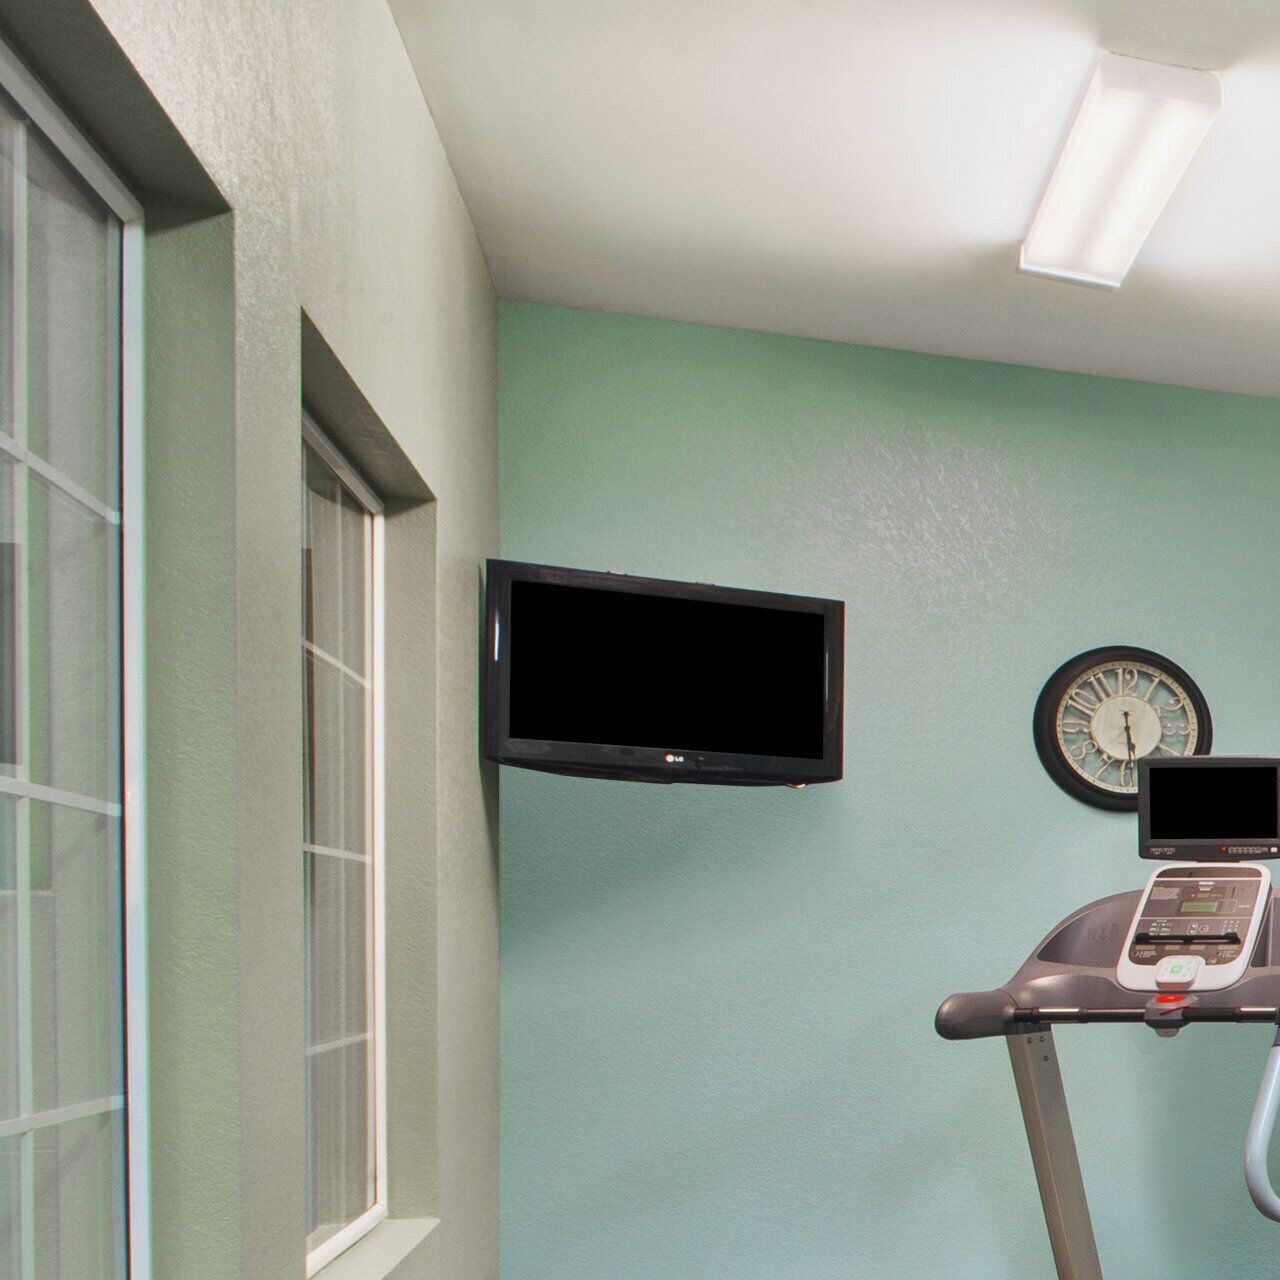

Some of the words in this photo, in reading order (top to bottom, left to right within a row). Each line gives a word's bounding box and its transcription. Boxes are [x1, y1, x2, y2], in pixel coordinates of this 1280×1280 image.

[1087, 672, 1113, 701] 11
[1115, 668, 1138, 696] 12
[1144, 675, 1160, 701] 1
[1067, 689, 1100, 716] 10
[1154, 697, 1183, 716] 2
[1161, 722, 1190, 735] 3
[1070, 740, 1098, 760] 8
